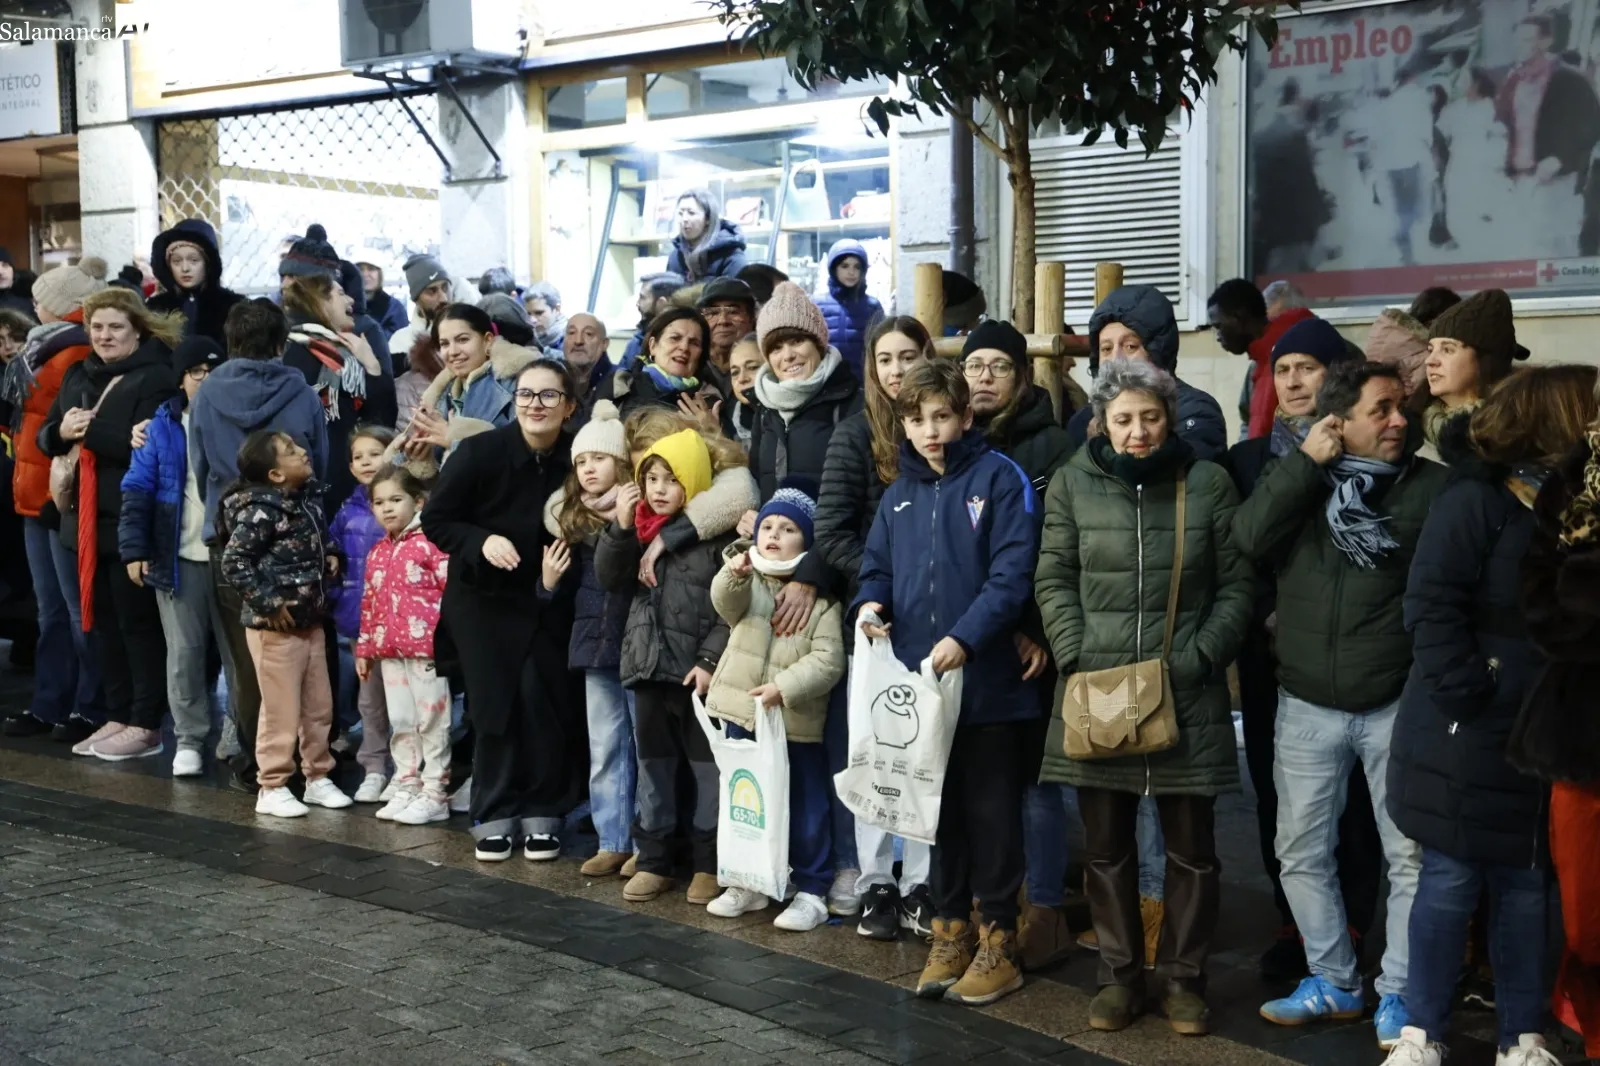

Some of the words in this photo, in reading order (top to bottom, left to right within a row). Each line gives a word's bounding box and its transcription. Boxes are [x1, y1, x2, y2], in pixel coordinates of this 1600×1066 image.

[1268, 18, 1412, 74] Empleo
[0, 73, 41, 91] TÉTICO
[0, 99, 41, 110] NTEGRAL
